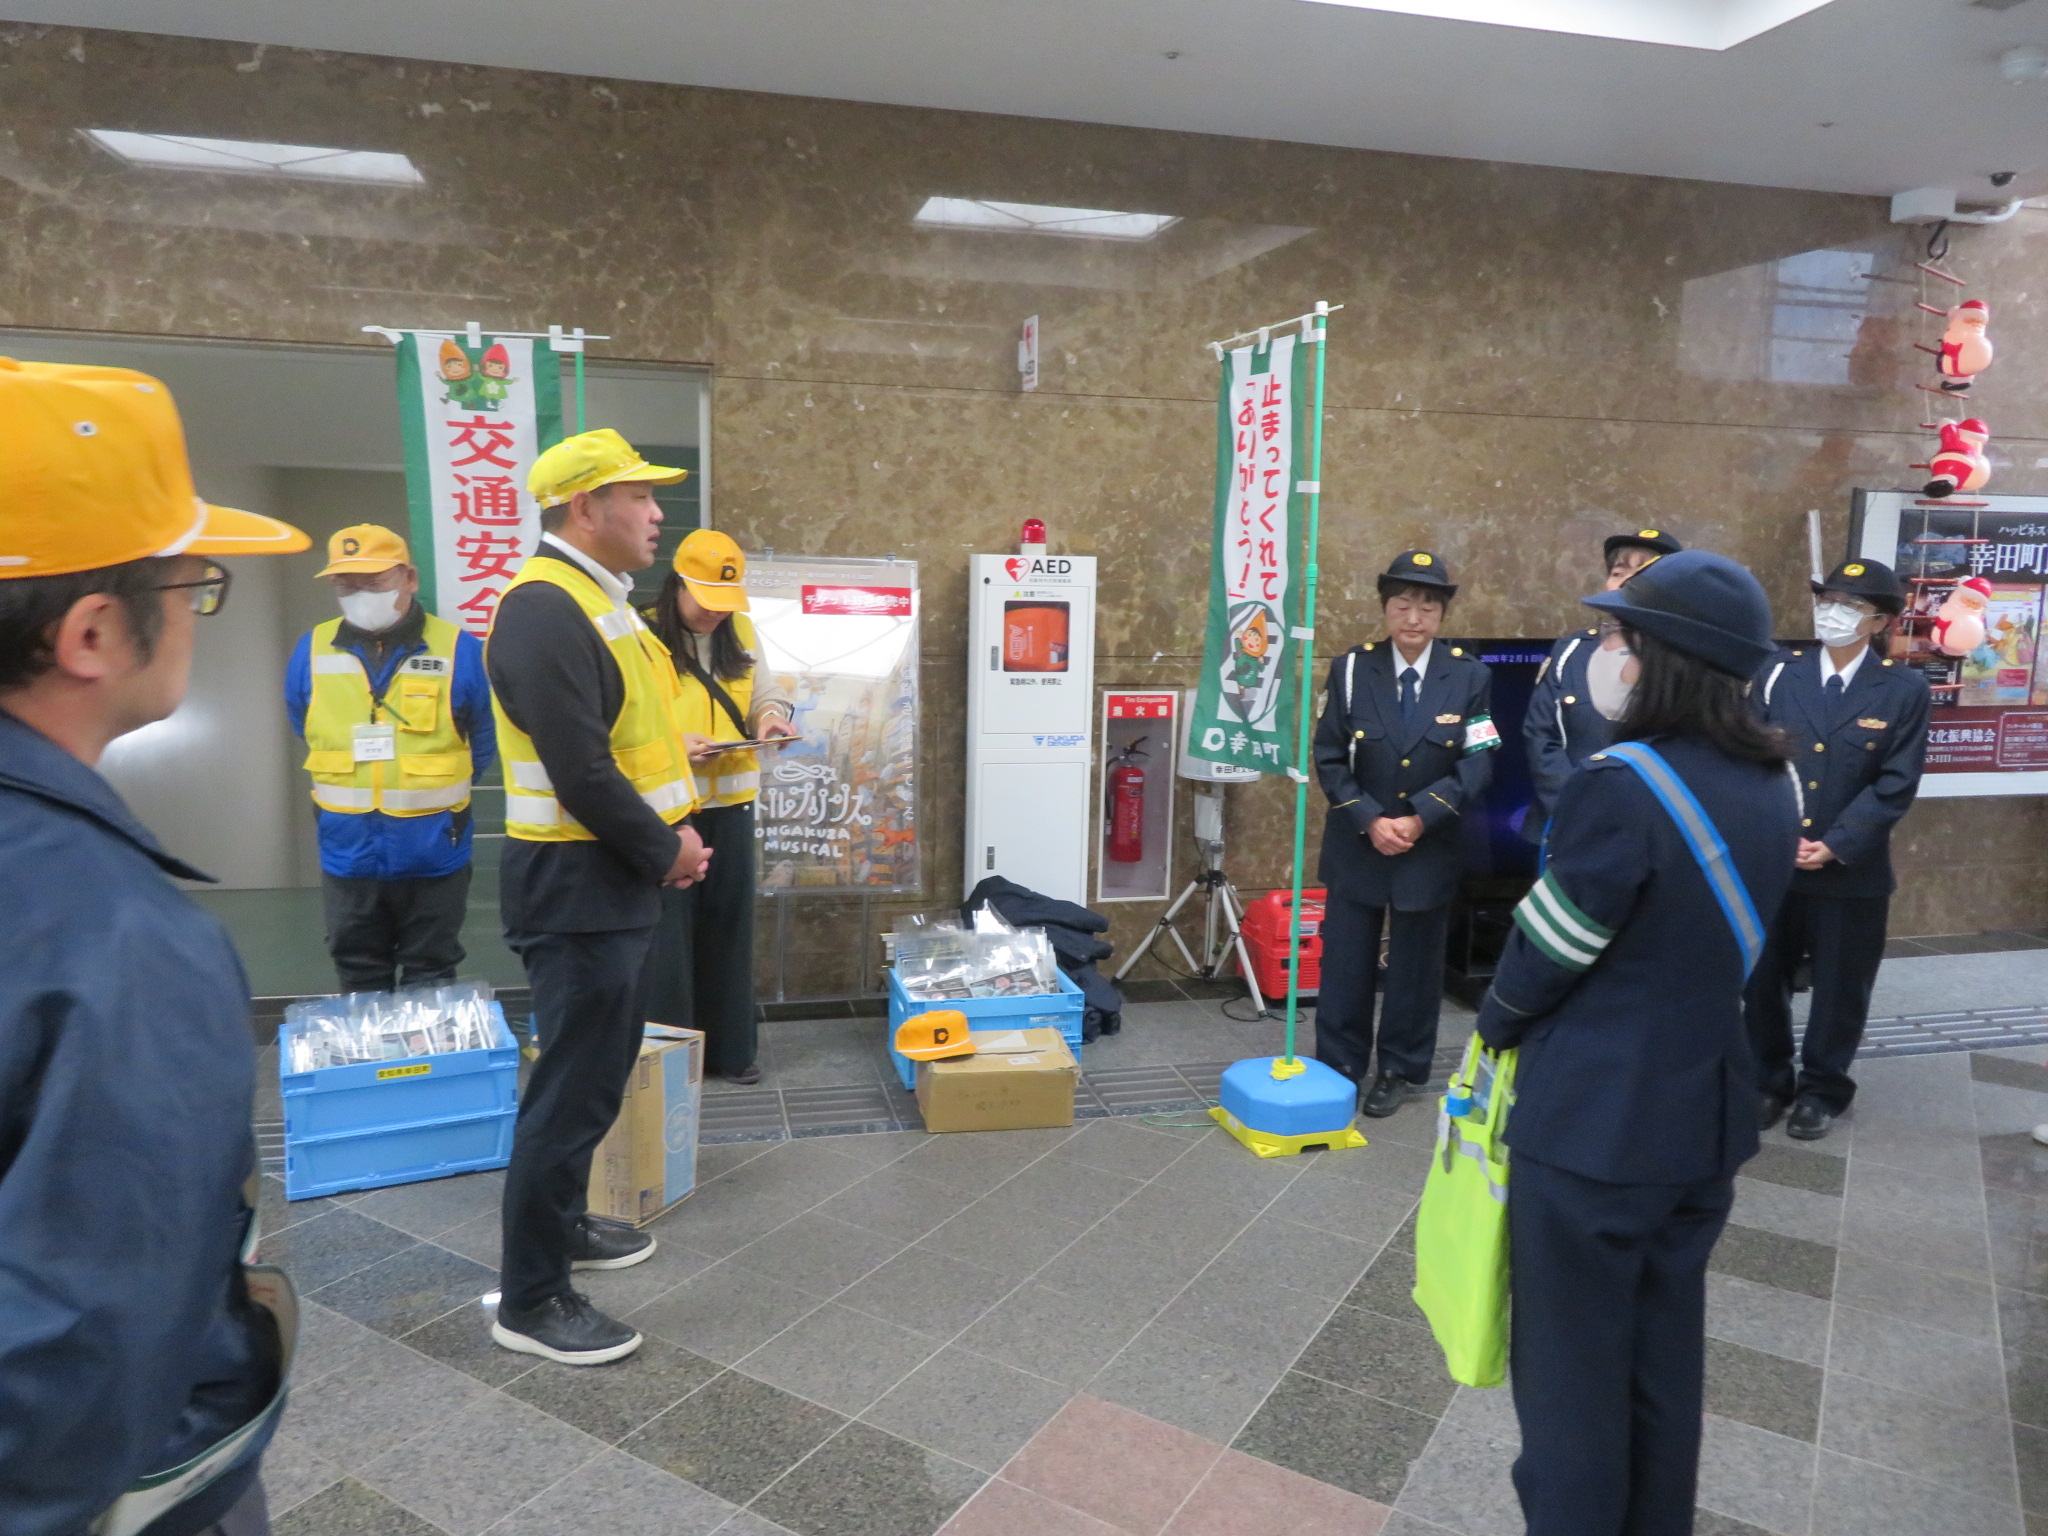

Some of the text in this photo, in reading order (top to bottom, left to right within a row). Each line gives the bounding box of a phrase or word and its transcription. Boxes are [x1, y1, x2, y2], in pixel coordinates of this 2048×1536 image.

[1260, 374, 1282, 601] 止まってくれて
[446, 415, 523, 638] 交通安全
[1031, 559, 1071, 574] AED
[1968, 543, 2048, 575] 幸田町
[410, 658, 443, 673] 幸田町
[1229, 730, 1281, 765] 幸田町
[755, 825, 851, 840] ONGAKUZA
[764, 841, 844, 858] MUSICAL
